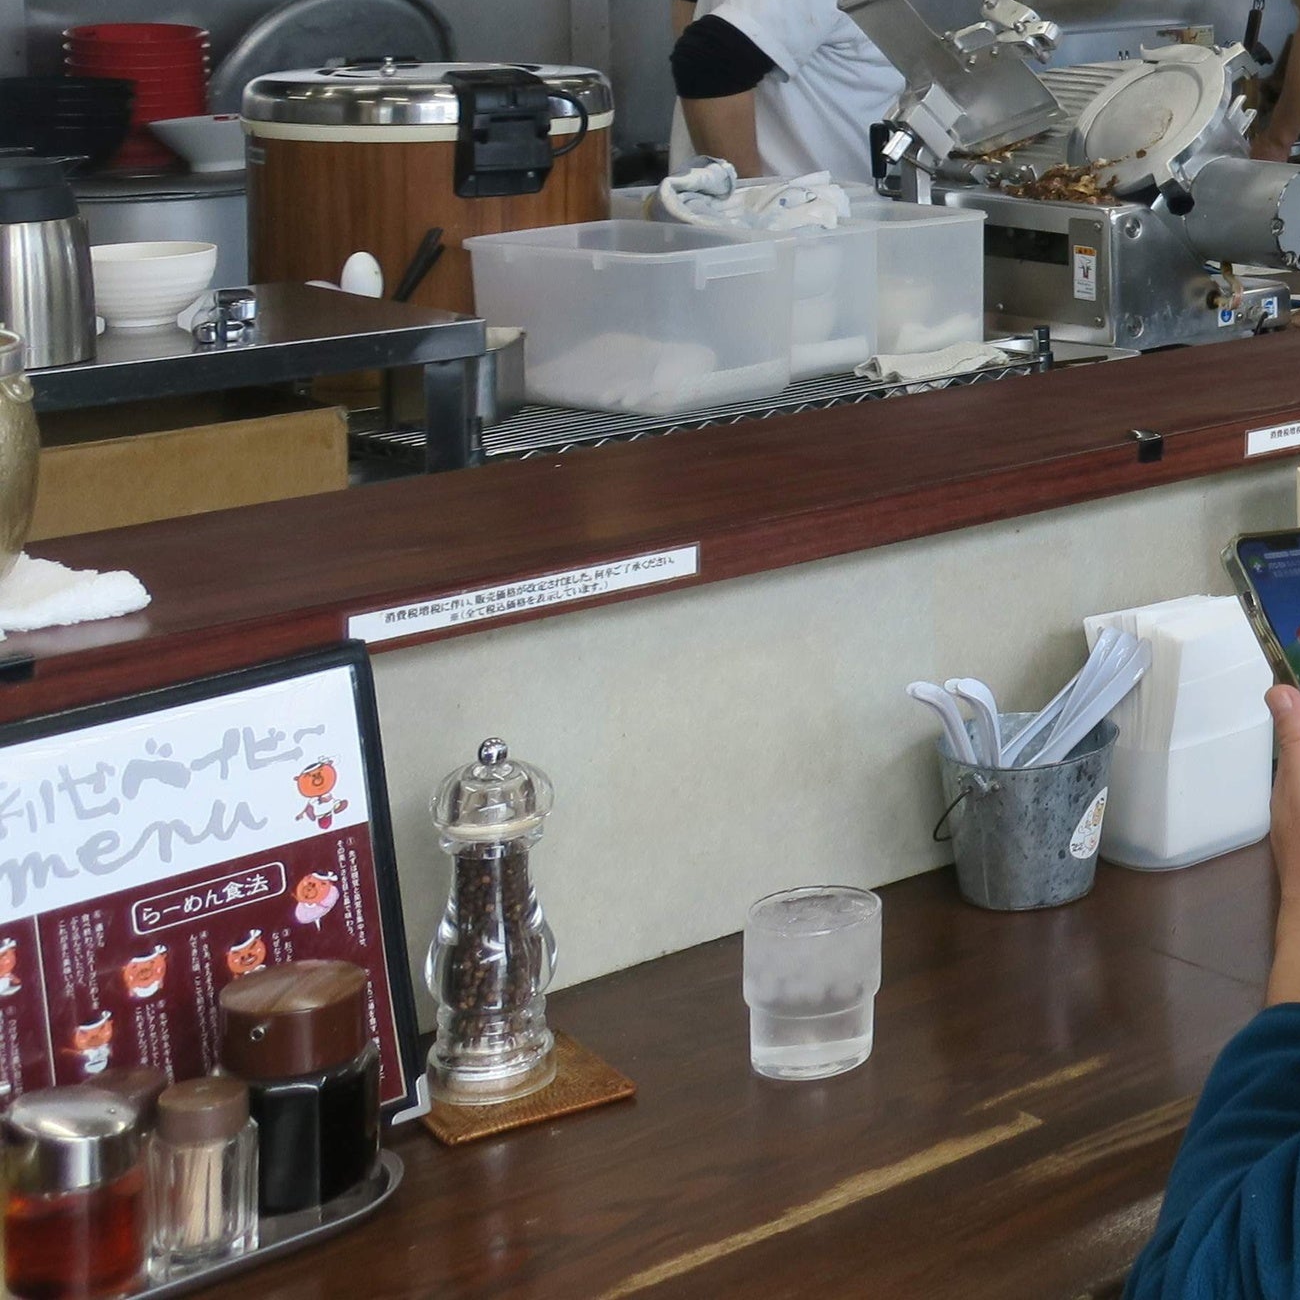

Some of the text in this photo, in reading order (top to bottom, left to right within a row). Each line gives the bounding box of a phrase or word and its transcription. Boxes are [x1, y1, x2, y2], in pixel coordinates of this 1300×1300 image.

[0, 798, 269, 910] menu
[141, 872, 270, 924] らーめん食法
